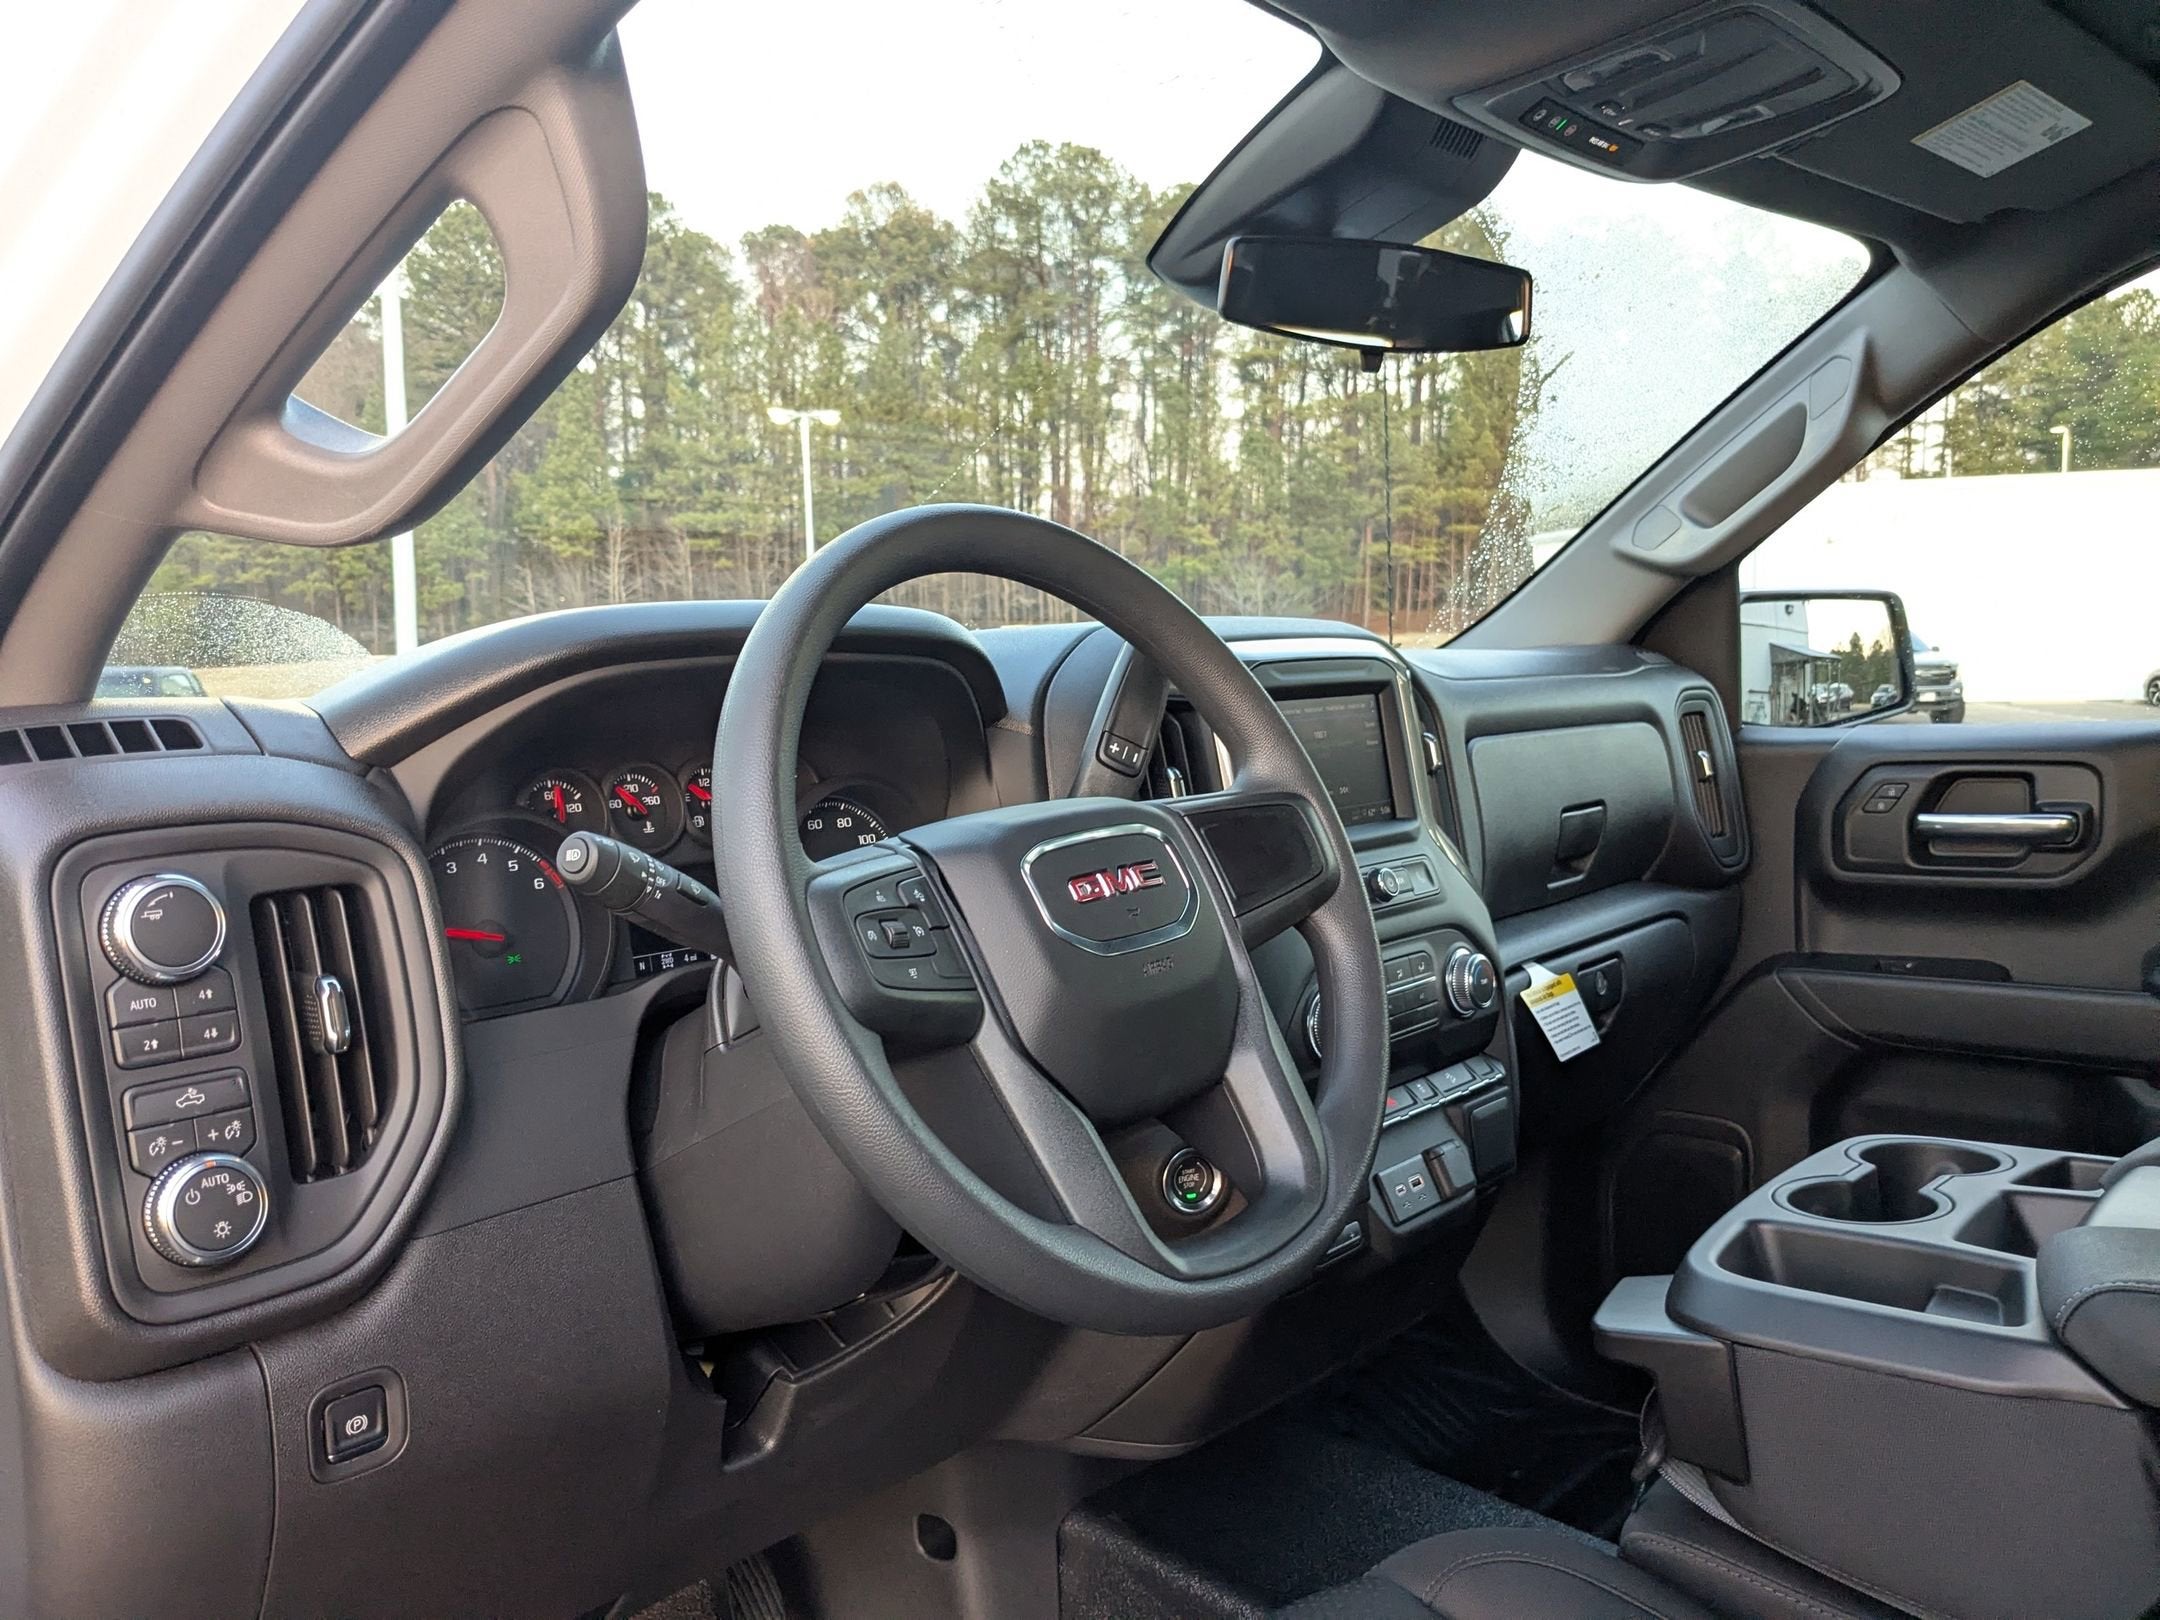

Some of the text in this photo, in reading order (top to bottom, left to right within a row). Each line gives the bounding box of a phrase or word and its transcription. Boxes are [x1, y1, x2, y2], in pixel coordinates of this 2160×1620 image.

[698, 778, 710, 787] 1/2
[642, 796, 660, 806] 260
[565, 803, 582, 813] 120
[807, 819, 823, 830] 60
[836, 817, 852, 828] 80
[857, 833, 876, 845] 100
[477, 853, 488, 864] 4
[446, 861, 457, 874] 3
[508, 860, 519, 872] 5
[534, 878, 545, 889] 6
[1068, 861, 1165, 902] GMC
[684, 953, 690, 962] 4
[198, 989, 206, 1000] 4
[130, 998, 157, 1011] AUTO
[203, 1028, 211, 1039] 4
[143, 1040, 150, 1051] 2
[201, 1173, 230, 1189] AUTO
[1178, 1173, 1200, 1184] ENGINE
